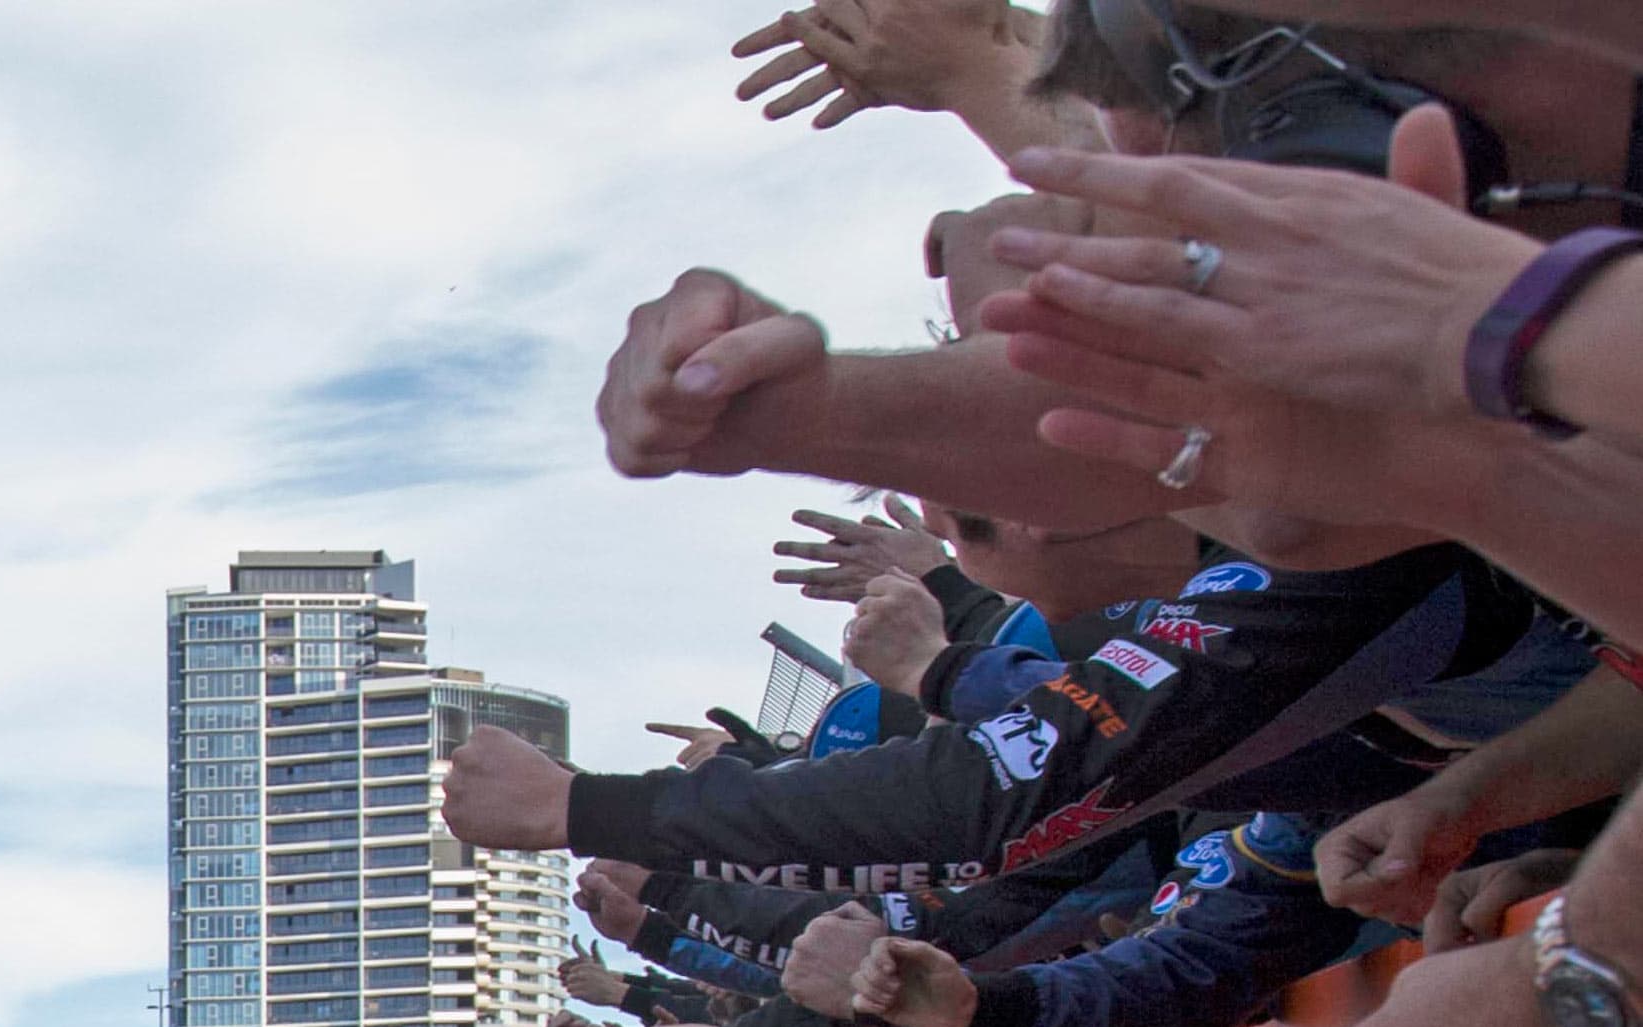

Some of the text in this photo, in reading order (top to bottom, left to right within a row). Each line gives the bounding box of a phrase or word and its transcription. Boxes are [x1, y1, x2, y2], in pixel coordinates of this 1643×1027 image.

[1159, 604, 1198, 618] pepsi
[693, 859, 984, 892] LIVE LIFE TO
[687, 912, 789, 970] LIVE LI
